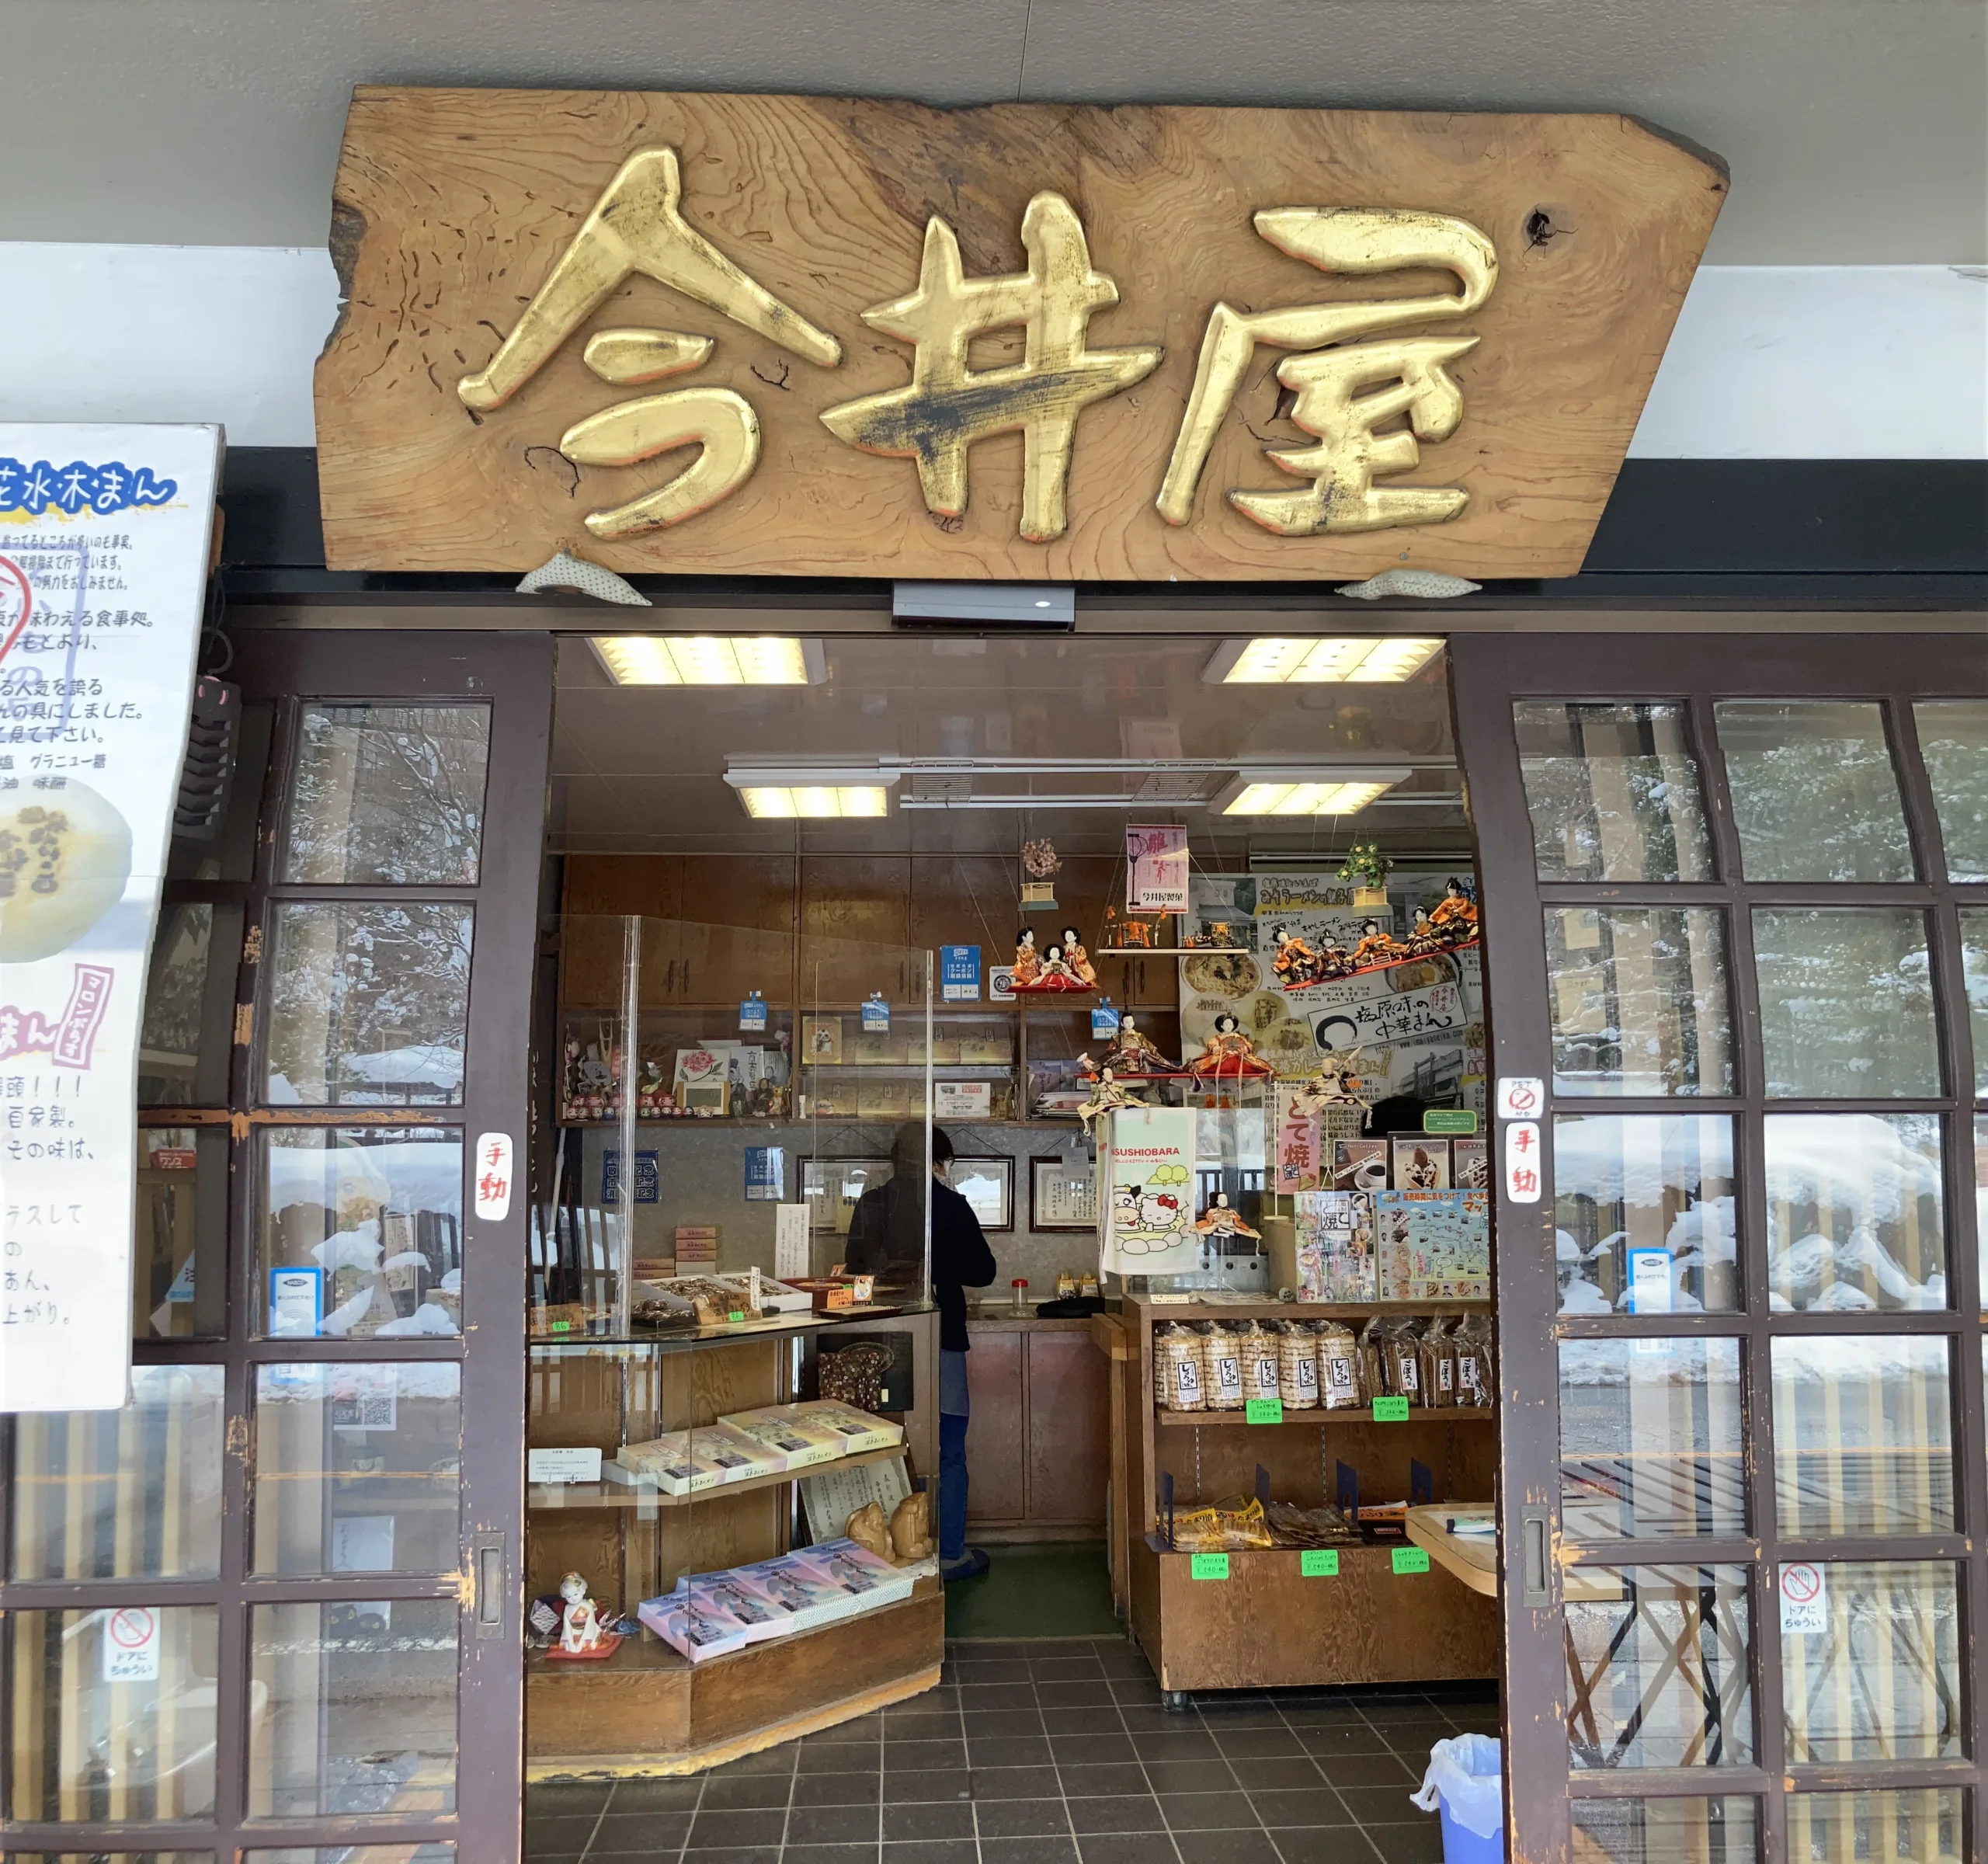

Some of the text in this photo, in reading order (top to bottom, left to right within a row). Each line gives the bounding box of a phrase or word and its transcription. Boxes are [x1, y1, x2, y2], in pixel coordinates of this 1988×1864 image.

[457, 145, 1500, 542] 今井屋
[1142, 892, 1183, 902] 今井屋製菓
[1375, 1011, 1452, 1039] 中華まん
[7, 1137, 94, 1160] その味は、
[1512, 1129, 1536, 1193] 手動
[478, 1141, 507, 1202] 手動
[1785, 1617, 1821, 1628] ちゅうい
[1788, 1605, 1816, 1615] ドアに
